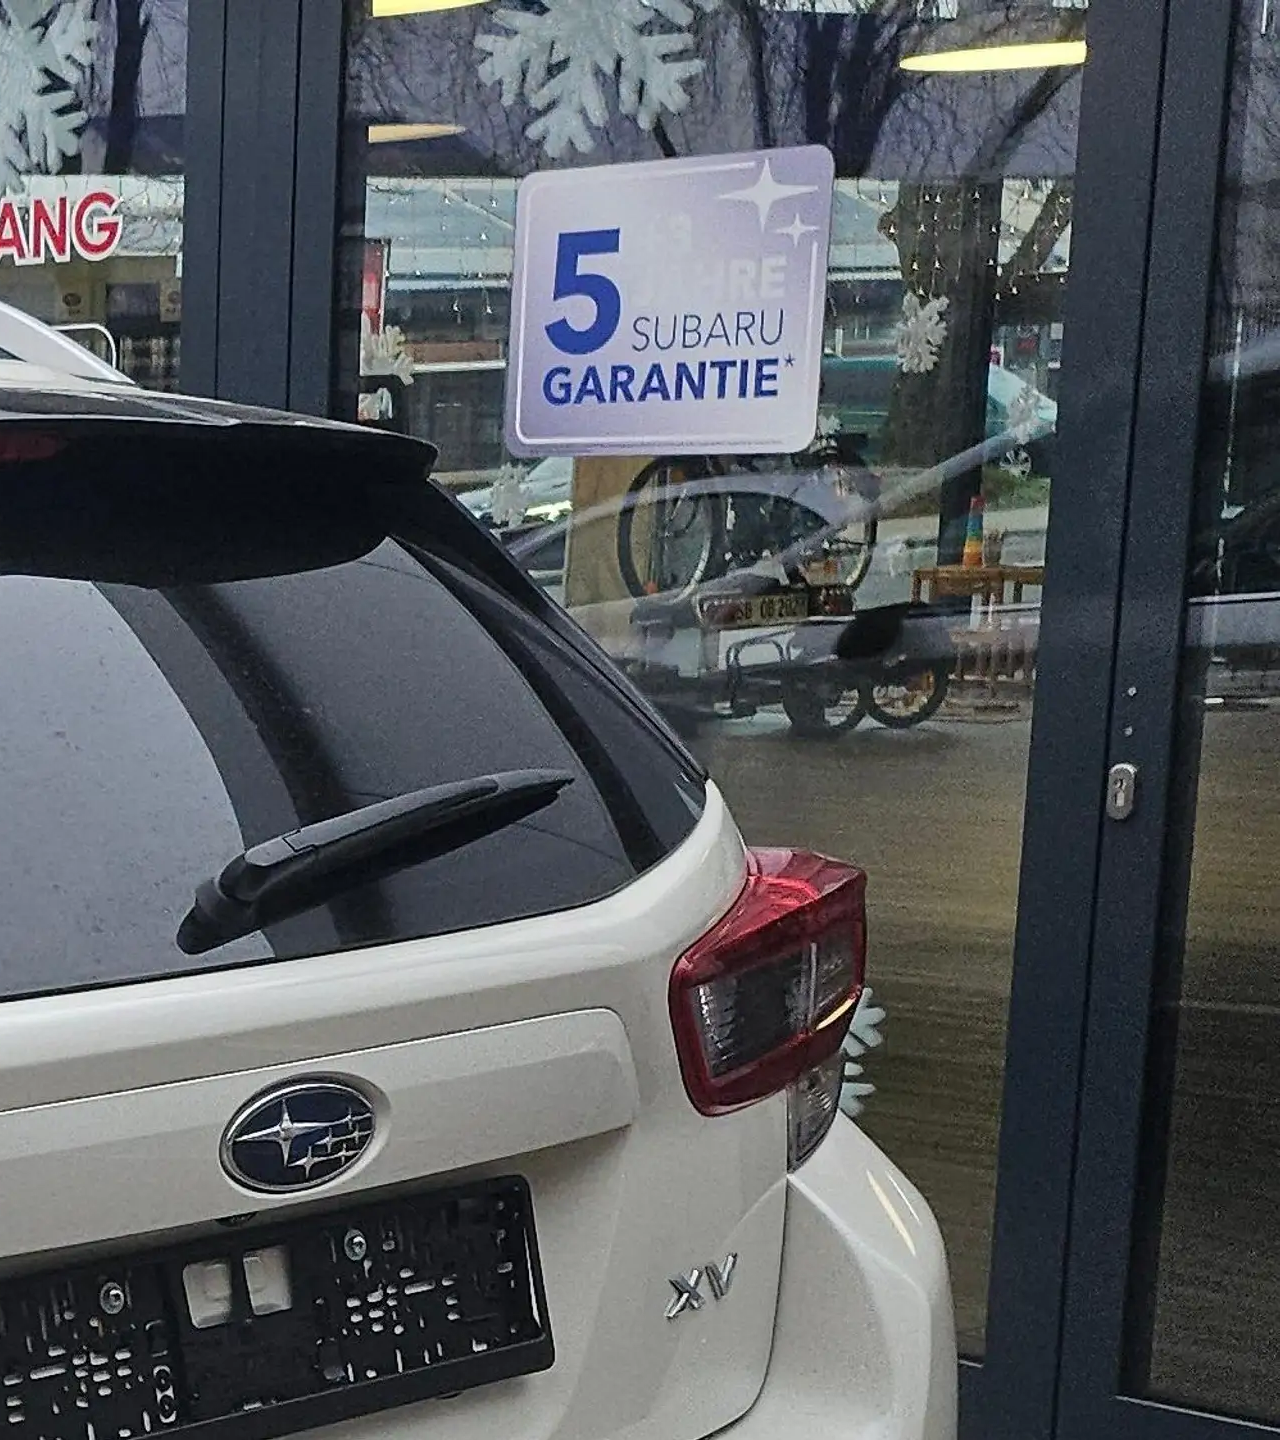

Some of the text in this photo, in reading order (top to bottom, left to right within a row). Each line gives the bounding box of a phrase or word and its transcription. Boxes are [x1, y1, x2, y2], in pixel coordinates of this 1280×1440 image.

[544, 227, 621, 356] 5
[631, 308, 785, 352] SUBARU
[659, 1252, 738, 1320] XV
